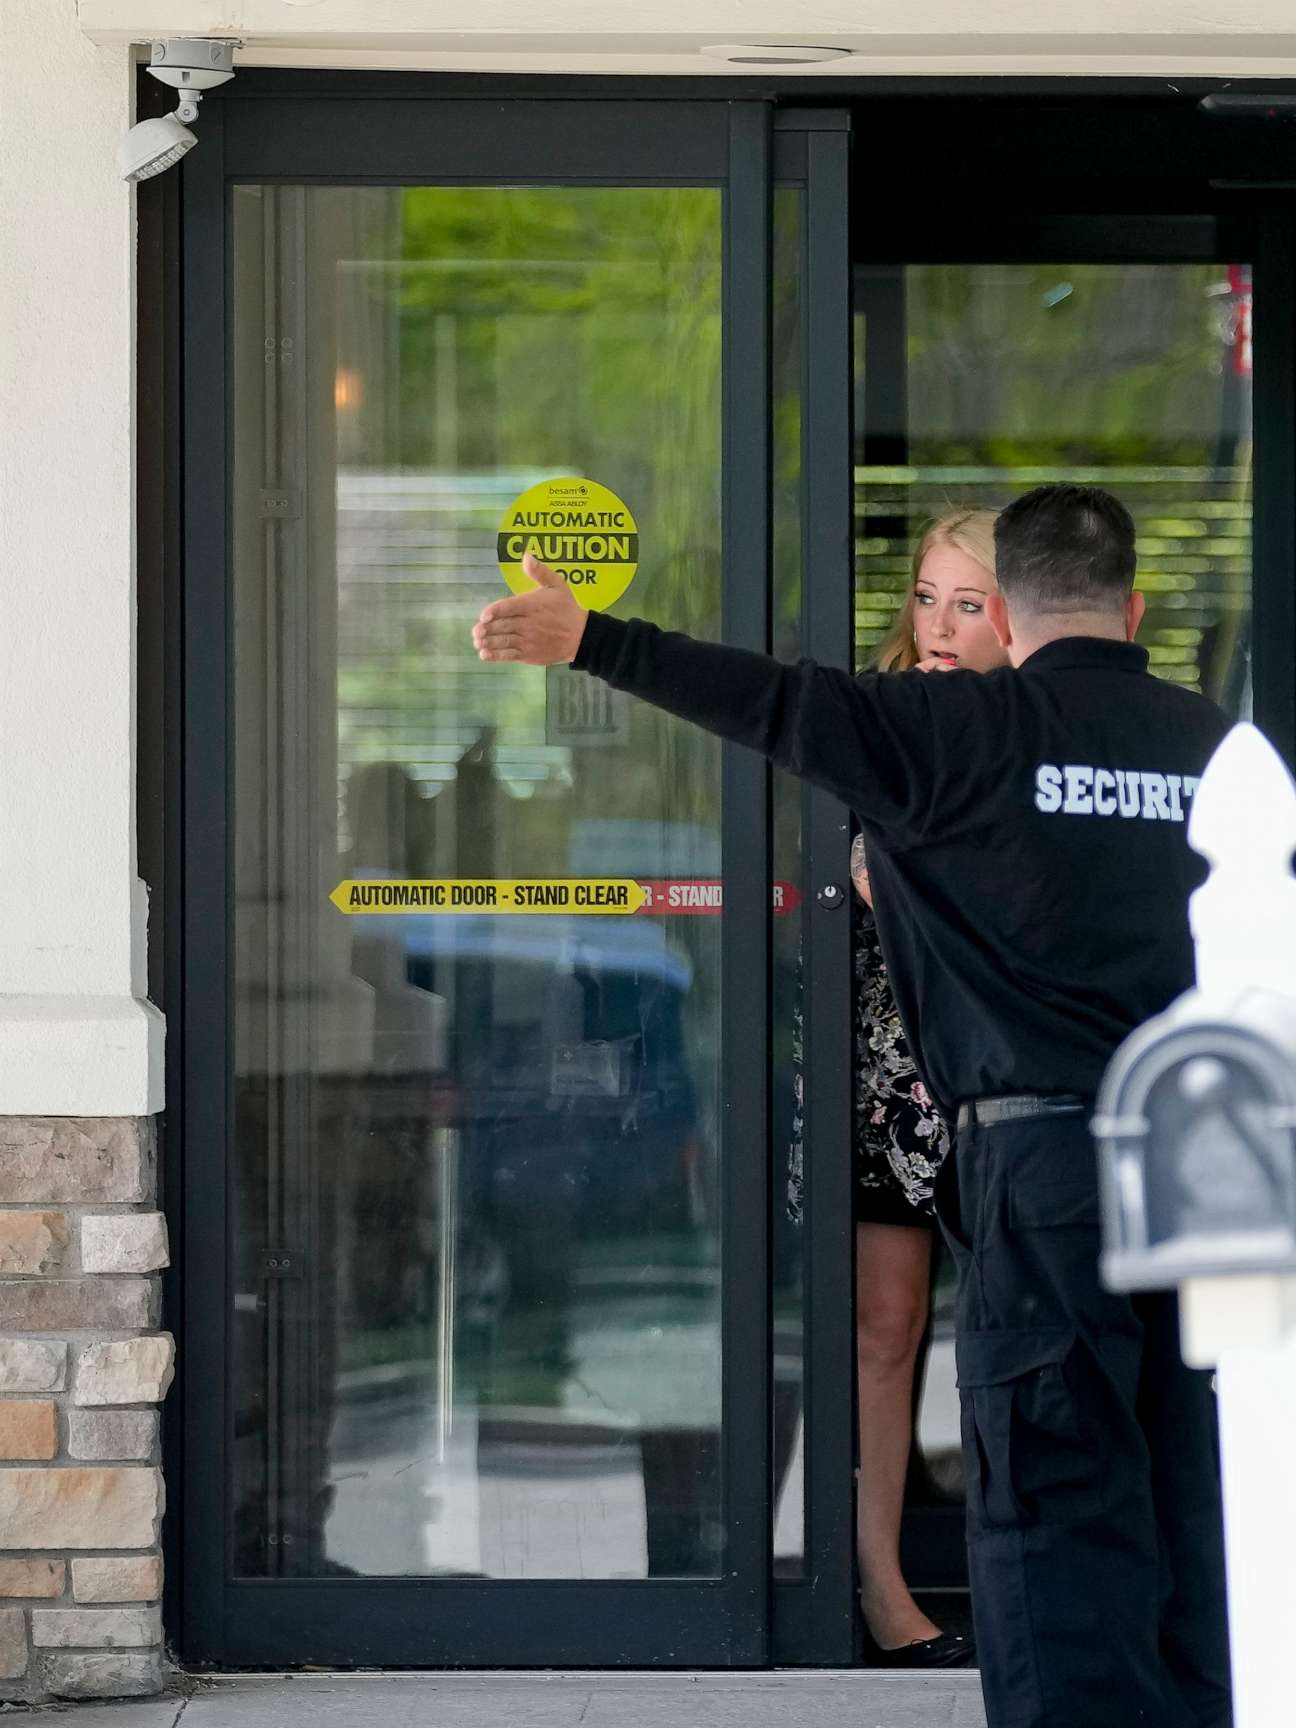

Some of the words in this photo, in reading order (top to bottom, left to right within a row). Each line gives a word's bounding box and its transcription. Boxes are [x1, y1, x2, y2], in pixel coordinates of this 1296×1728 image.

[549, 486, 578, 495] besam
[512, 511, 625, 528] AUTOMATIC
[506, 535, 630, 561] CAUTION
[554, 569, 598, 585] OOR
[350, 885, 446, 906] AUTOMATIC
[451, 885, 497, 906] DOOR
[514, 885, 569, 906] STAND
[574, 885, 628, 906] CLEAR
[668, 886, 722, 907] STAND
